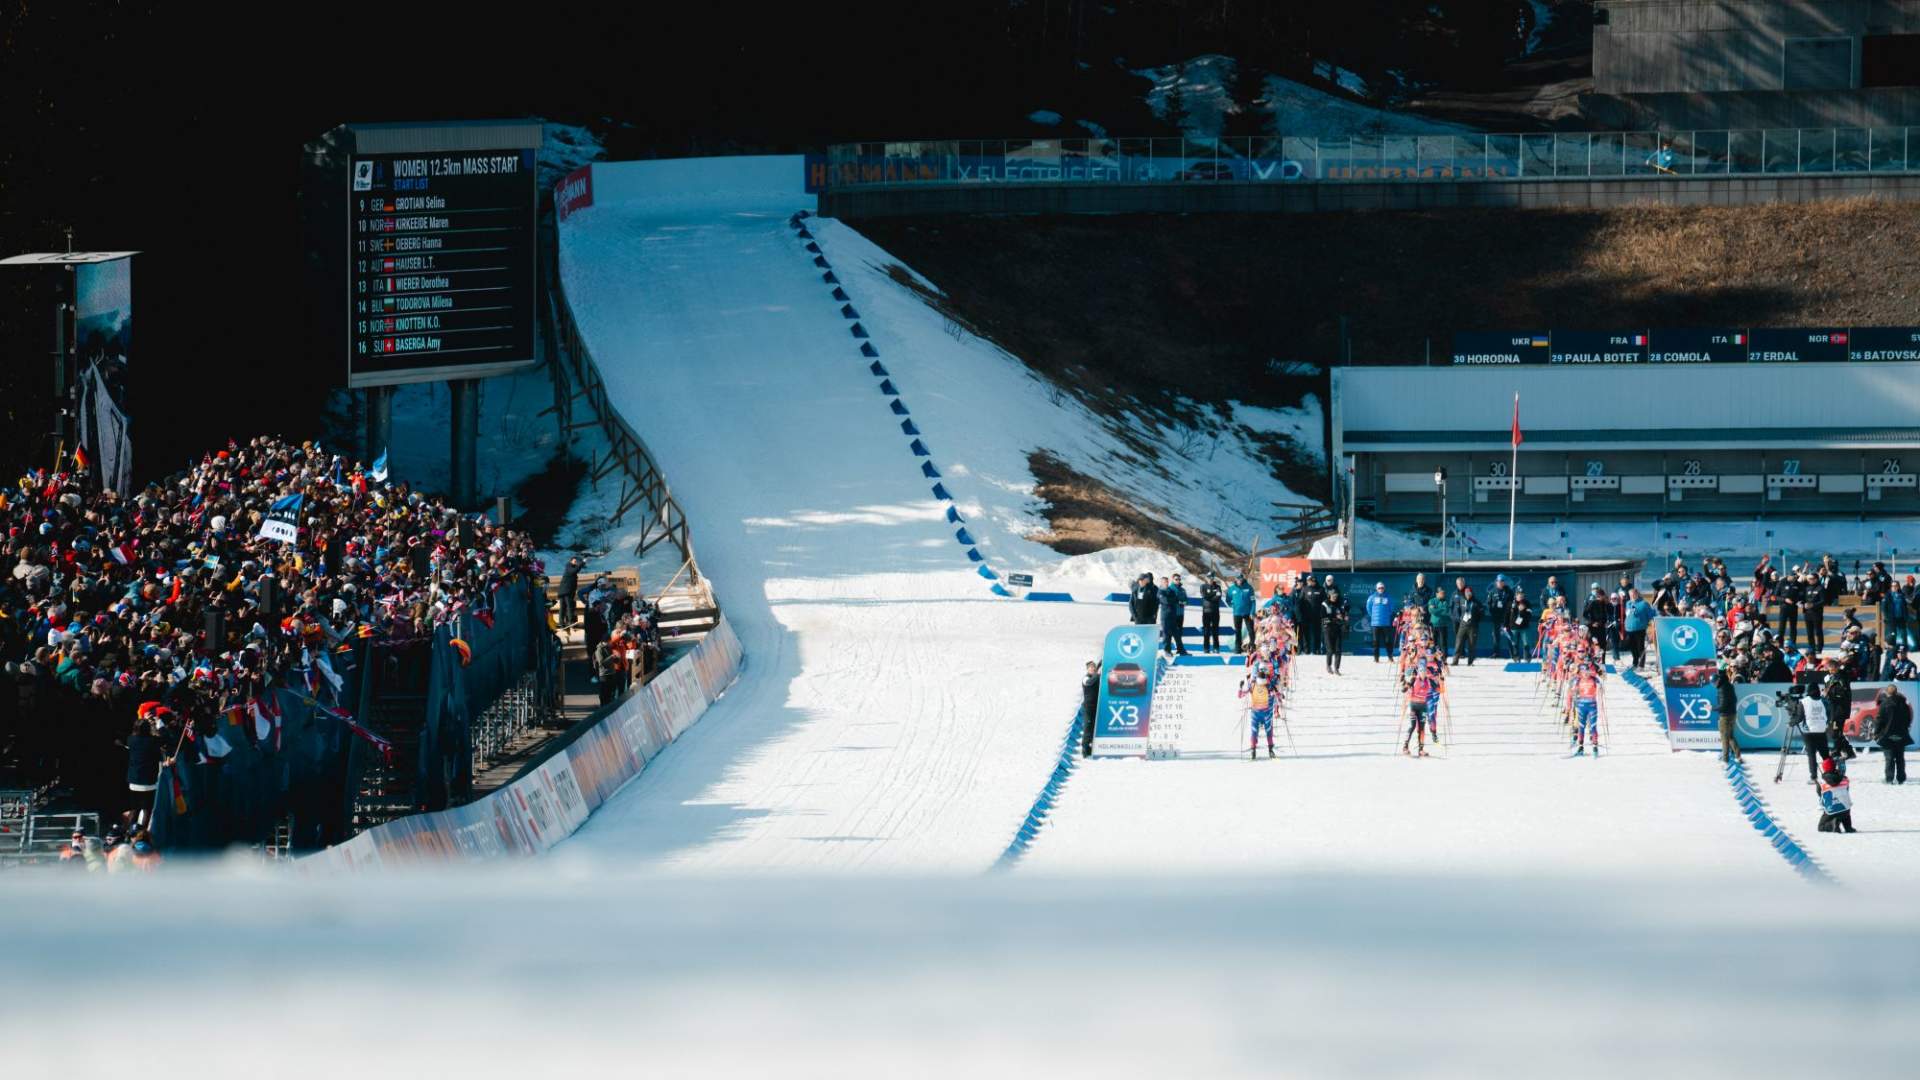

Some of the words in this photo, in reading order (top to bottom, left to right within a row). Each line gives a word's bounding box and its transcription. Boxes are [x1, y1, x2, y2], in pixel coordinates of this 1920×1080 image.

[393, 160, 428, 177] WOMEN
[430, 158, 462, 176] 12.5km
[463, 157, 489, 175] MASS
[490, 156, 519, 174] START
[359, 200, 365, 212] 9
[371, 199, 384, 212] GER
[396, 197, 424, 211] GROTIAN
[425, 196, 446, 209] Selina
[358, 220, 367, 232] 10
[370, 219, 384, 232] NOR
[429, 216, 449, 228] Maren
[358, 241, 366, 252] 11
[370, 239, 384, 252] SWE
[396, 237, 421, 250] OEBERG
[422, 236, 442, 249] Hanna
[358, 261, 367, 273] 12
[371, 259, 384, 272] AUT
[396, 257, 422, 271] HAUSER
[422, 257, 435, 269] L.T.
[358, 281, 367, 292] 13
[373, 279, 384, 291] ITA
[396, 277, 420, 290] WIERER
[421, 276, 449, 289] Dorothea
[358, 301, 367, 312] 14
[371, 300, 384, 312] BUL
[396, 298, 431, 311] TODOROVA
[431, 296, 453, 308] Milena
[358, 321, 367, 333] 15
[370, 319, 384, 332] NOR
[396, 317, 426, 331] KNOTTEN
[427, 316, 441, 328] K.O.
[358, 341, 367, 353] 16
[374, 339, 384, 351] SUI
[396, 338, 426, 351] BASERGA
[426, 337, 441, 352] Amy
[1610, 337, 1628, 345] FRA
[1808, 335, 1828, 343] NOR
[1453, 355, 1465, 363] 30
[1467, 354, 1520, 364] HORODNA
[1551, 354, 1563, 362] 29
[1565, 353, 1601, 363] PAULA
[1604, 352, 1640, 362] BOTET
[1650, 353, 1661, 361] 28
[1663, 352, 1711, 362] COMOLA
[1750, 353, 1761, 361] 27
[1763, 352, 1799, 361] ERDAL
[1850, 352, 1861, 360] 26
[1490, 462, 1506, 476] 30
[1586, 461, 1603, 476] 29
[1684, 460, 1700, 475] 28
[1783, 460, 1800, 474] 27
[1883, 459, 1900, 474] 26
[1108, 706, 1139, 726] X3
[1679, 699, 1712, 719] X3
